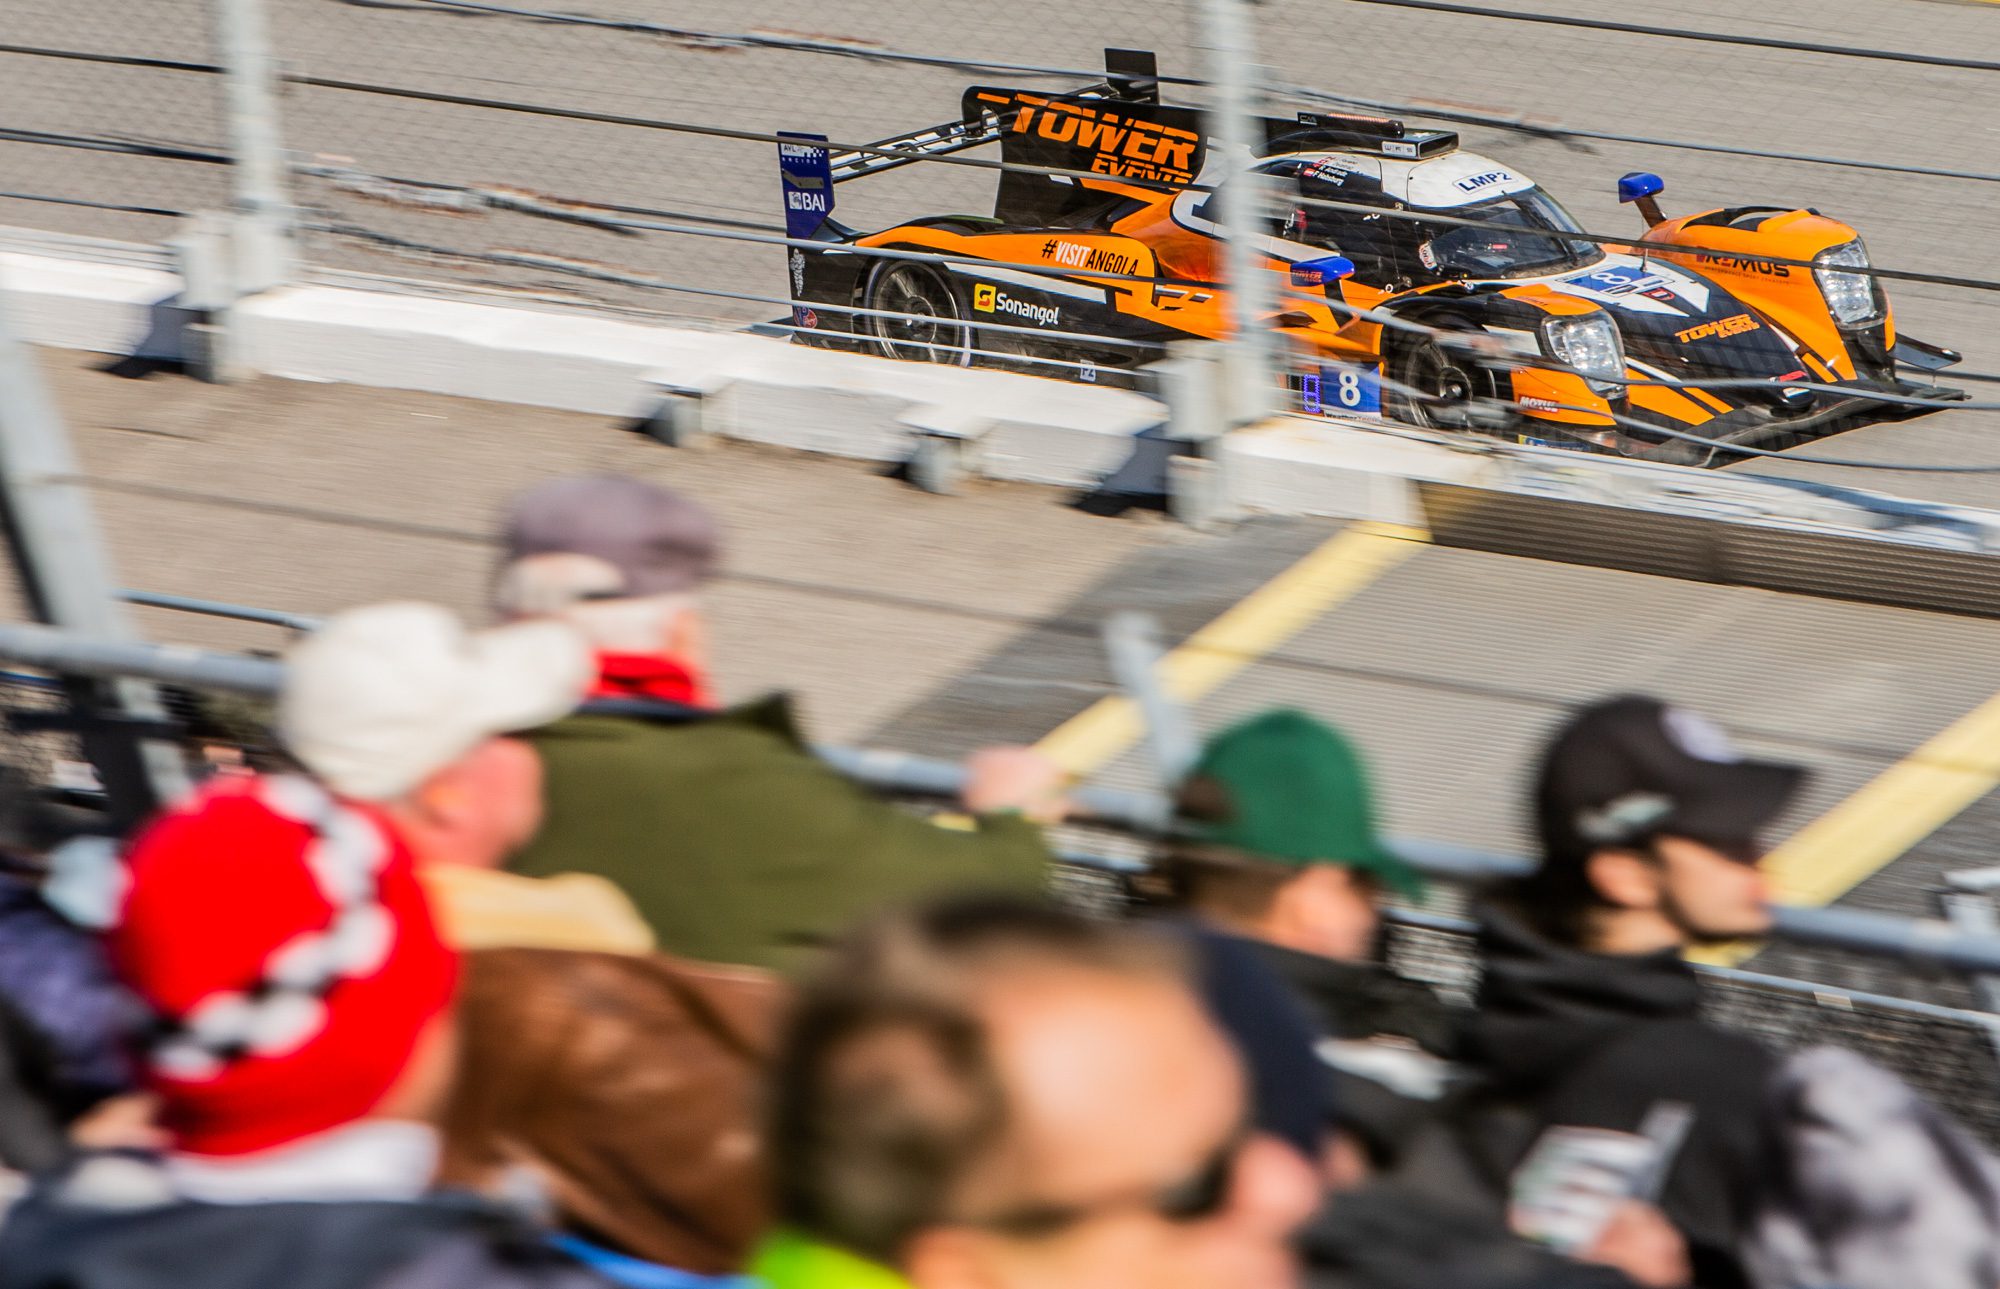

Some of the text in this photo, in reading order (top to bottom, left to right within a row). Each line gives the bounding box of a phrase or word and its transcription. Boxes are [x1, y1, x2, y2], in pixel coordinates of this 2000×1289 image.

[1012, 93, 1199, 170] TOWER
[1458, 171, 1512, 191] LMP2
[802, 192, 826, 212] BAI
[1590, 272, 1632, 285] 8
[995, 291, 1060, 326] Sonangol
[1673, 313, 1752, 344] TOWER
[1338, 370, 1361, 407] 8
